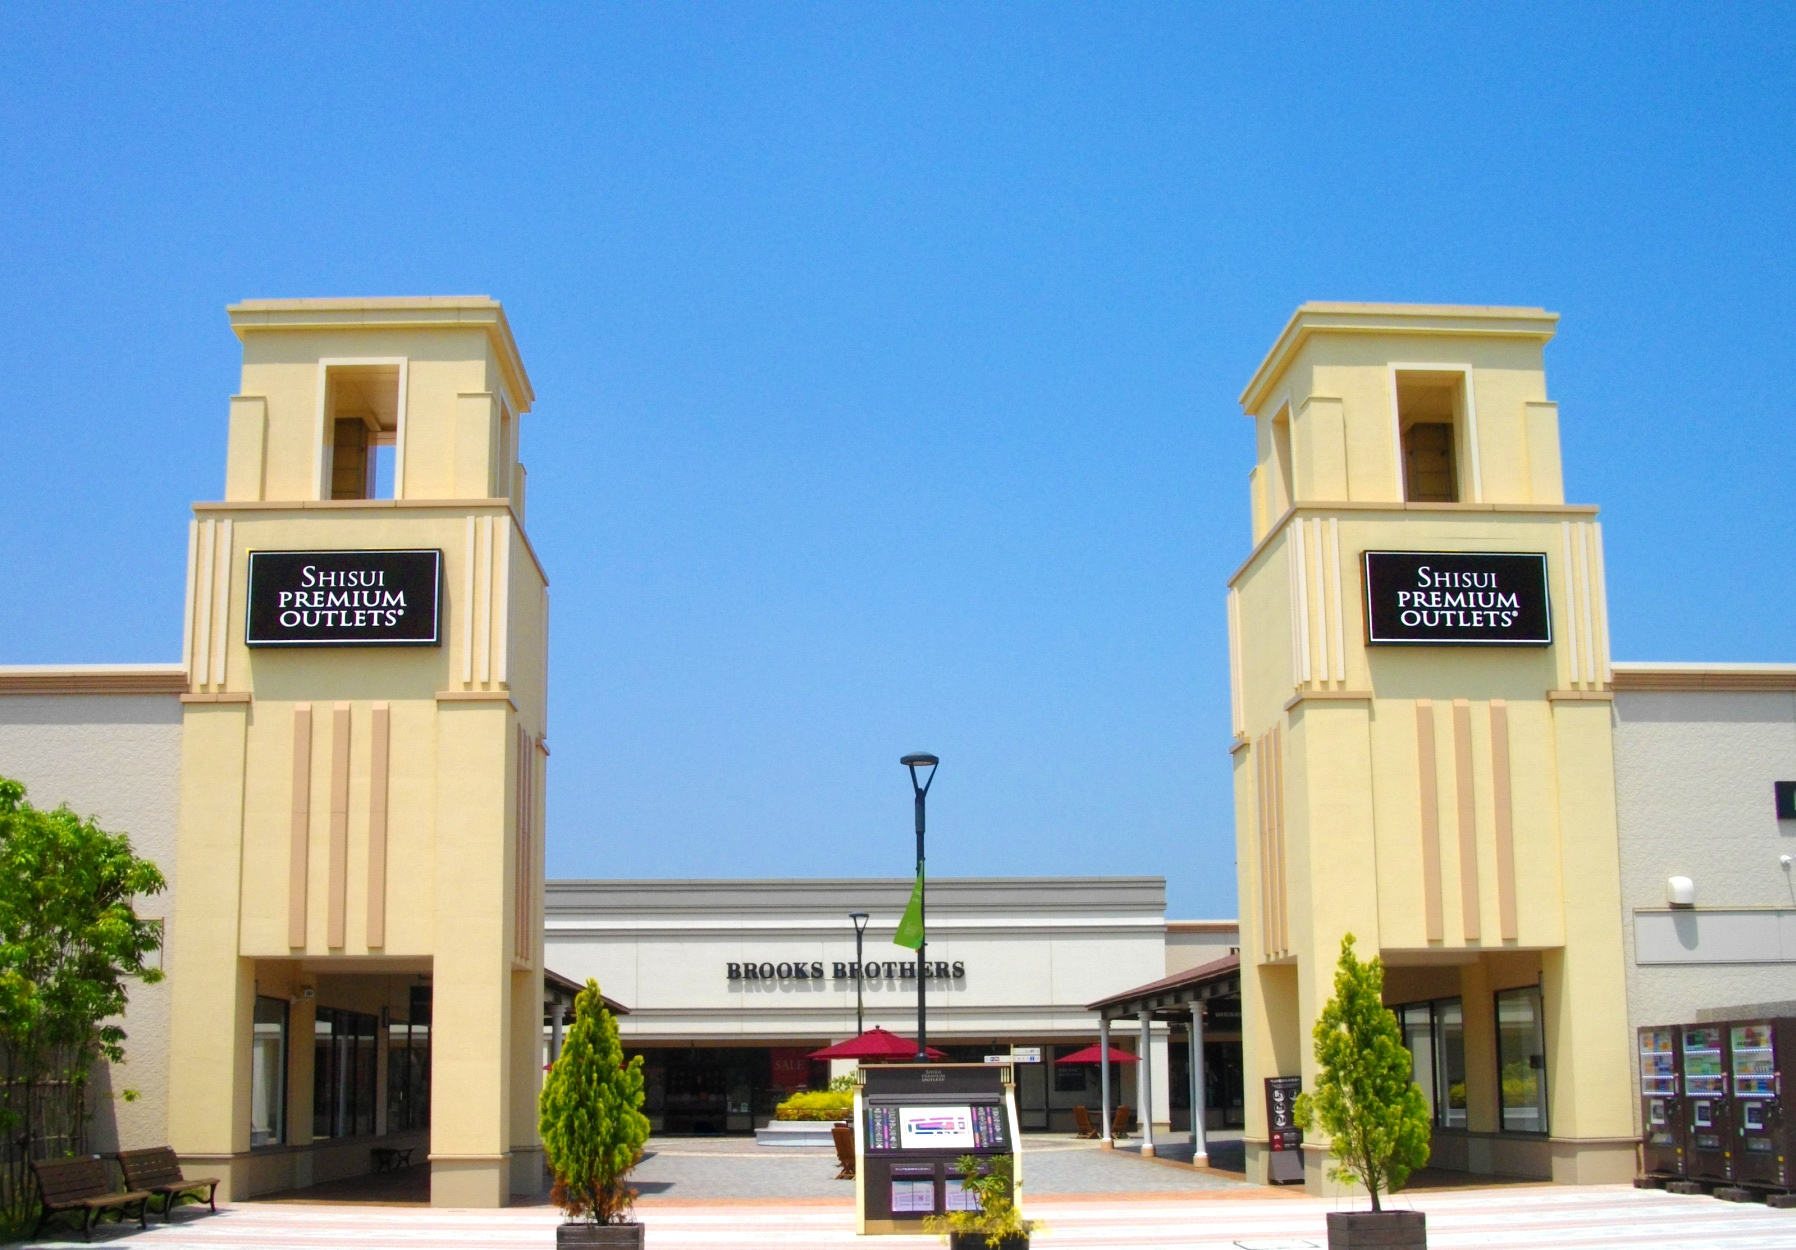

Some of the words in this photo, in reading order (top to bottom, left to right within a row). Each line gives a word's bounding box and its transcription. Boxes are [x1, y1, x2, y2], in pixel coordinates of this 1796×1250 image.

[278, 590, 407, 608] PREMIUM
[1397, 591, 1520, 608] PREMIUM
[726, 962, 824, 979] BROOKS
[832, 961, 965, 979] BROTHERS
[774, 1059, 805, 1070] SALE
